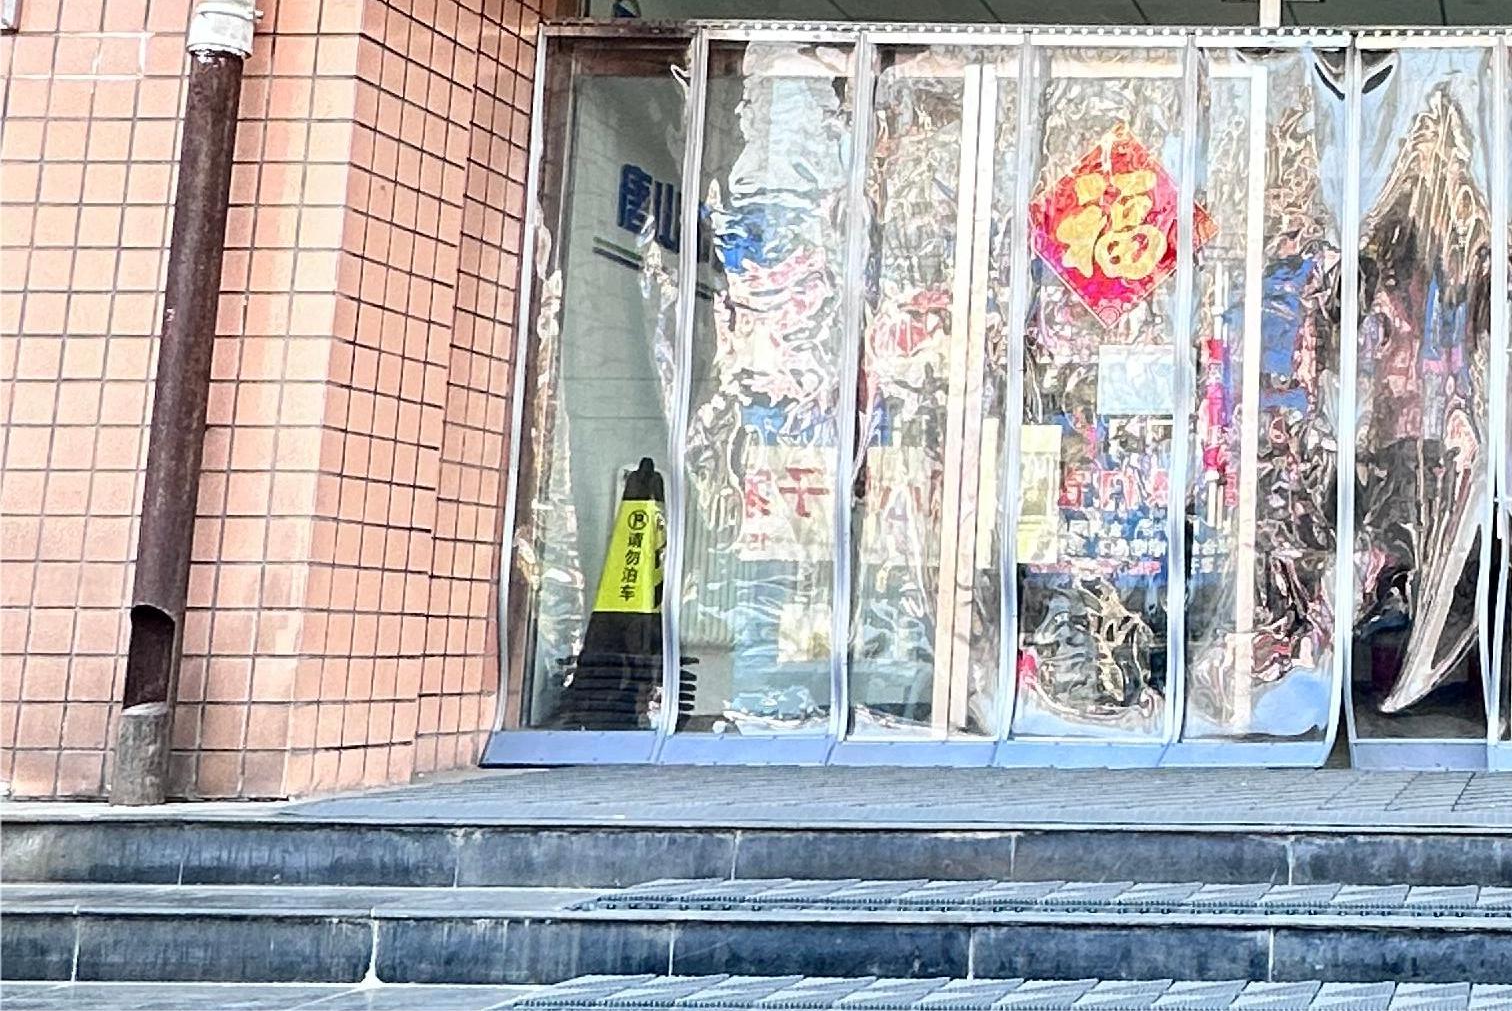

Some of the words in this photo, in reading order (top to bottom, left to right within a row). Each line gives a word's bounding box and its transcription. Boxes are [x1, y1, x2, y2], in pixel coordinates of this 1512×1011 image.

[1056, 169, 1168, 280] 福
[620, 532, 644, 602] 请勿泊车
